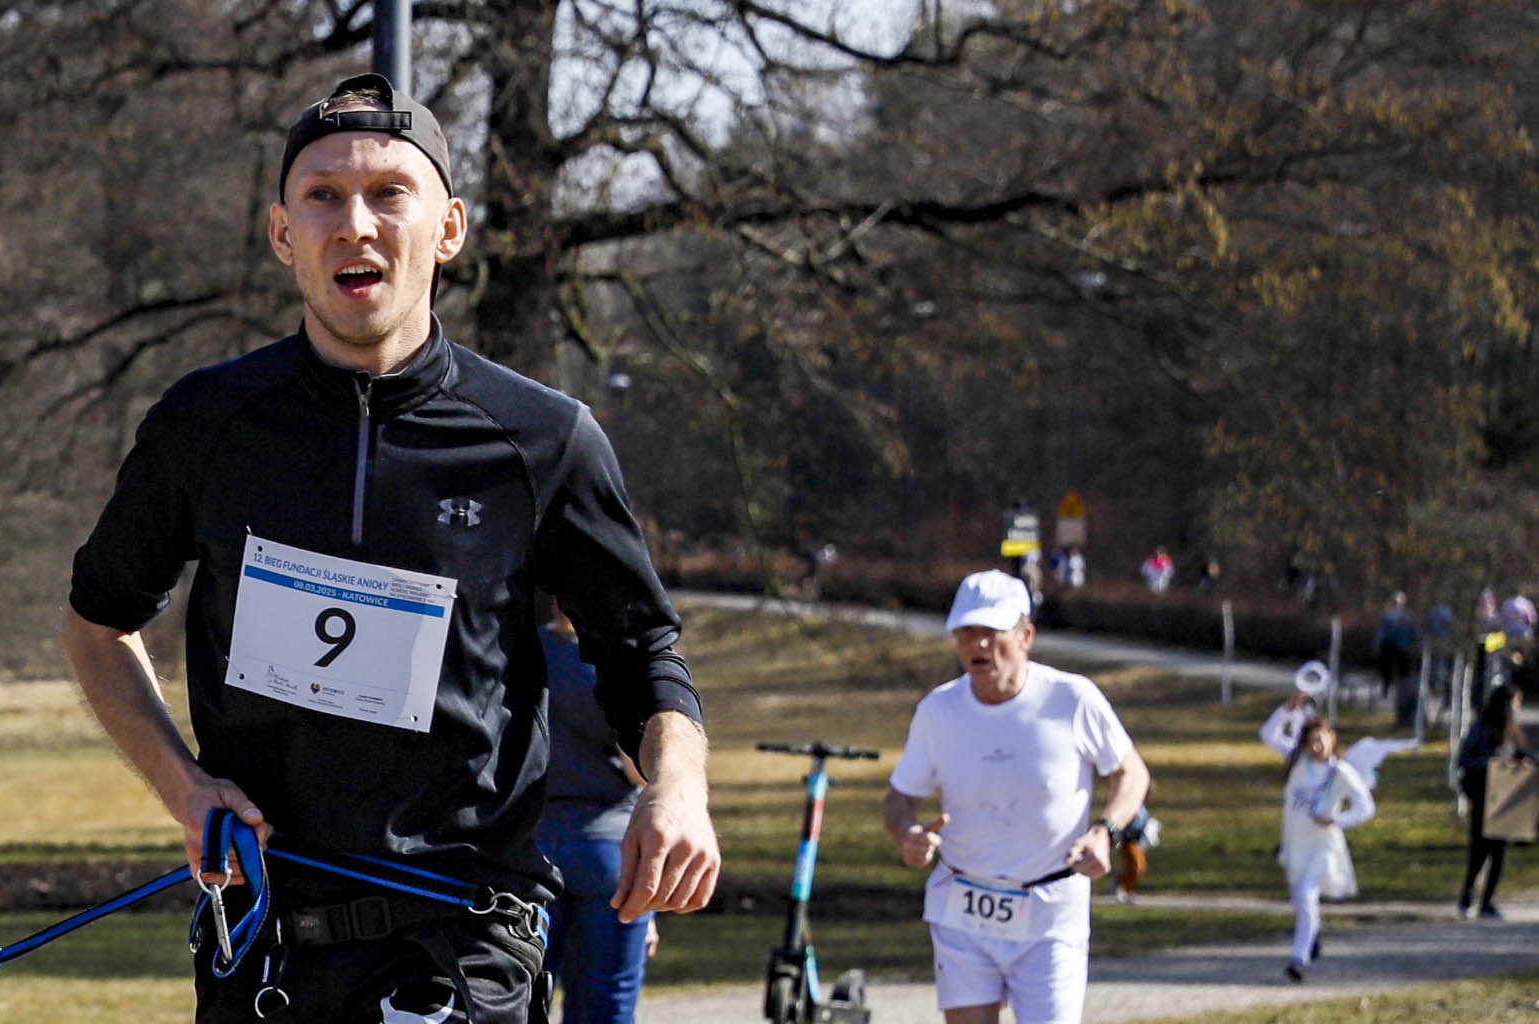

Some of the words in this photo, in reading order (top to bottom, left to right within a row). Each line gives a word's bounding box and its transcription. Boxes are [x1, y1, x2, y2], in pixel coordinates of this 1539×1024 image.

[264, 555, 283, 568] BIEG
[283, 561, 322, 578] FUNDACJI
[323, 568, 356, 585] ŚLĄSKIE
[356, 577, 389, 590] ANIOŁY
[341, 591, 389, 607] KATOWICE
[313, 607, 356, 668] 9
[963, 890, 1013, 923] 105
